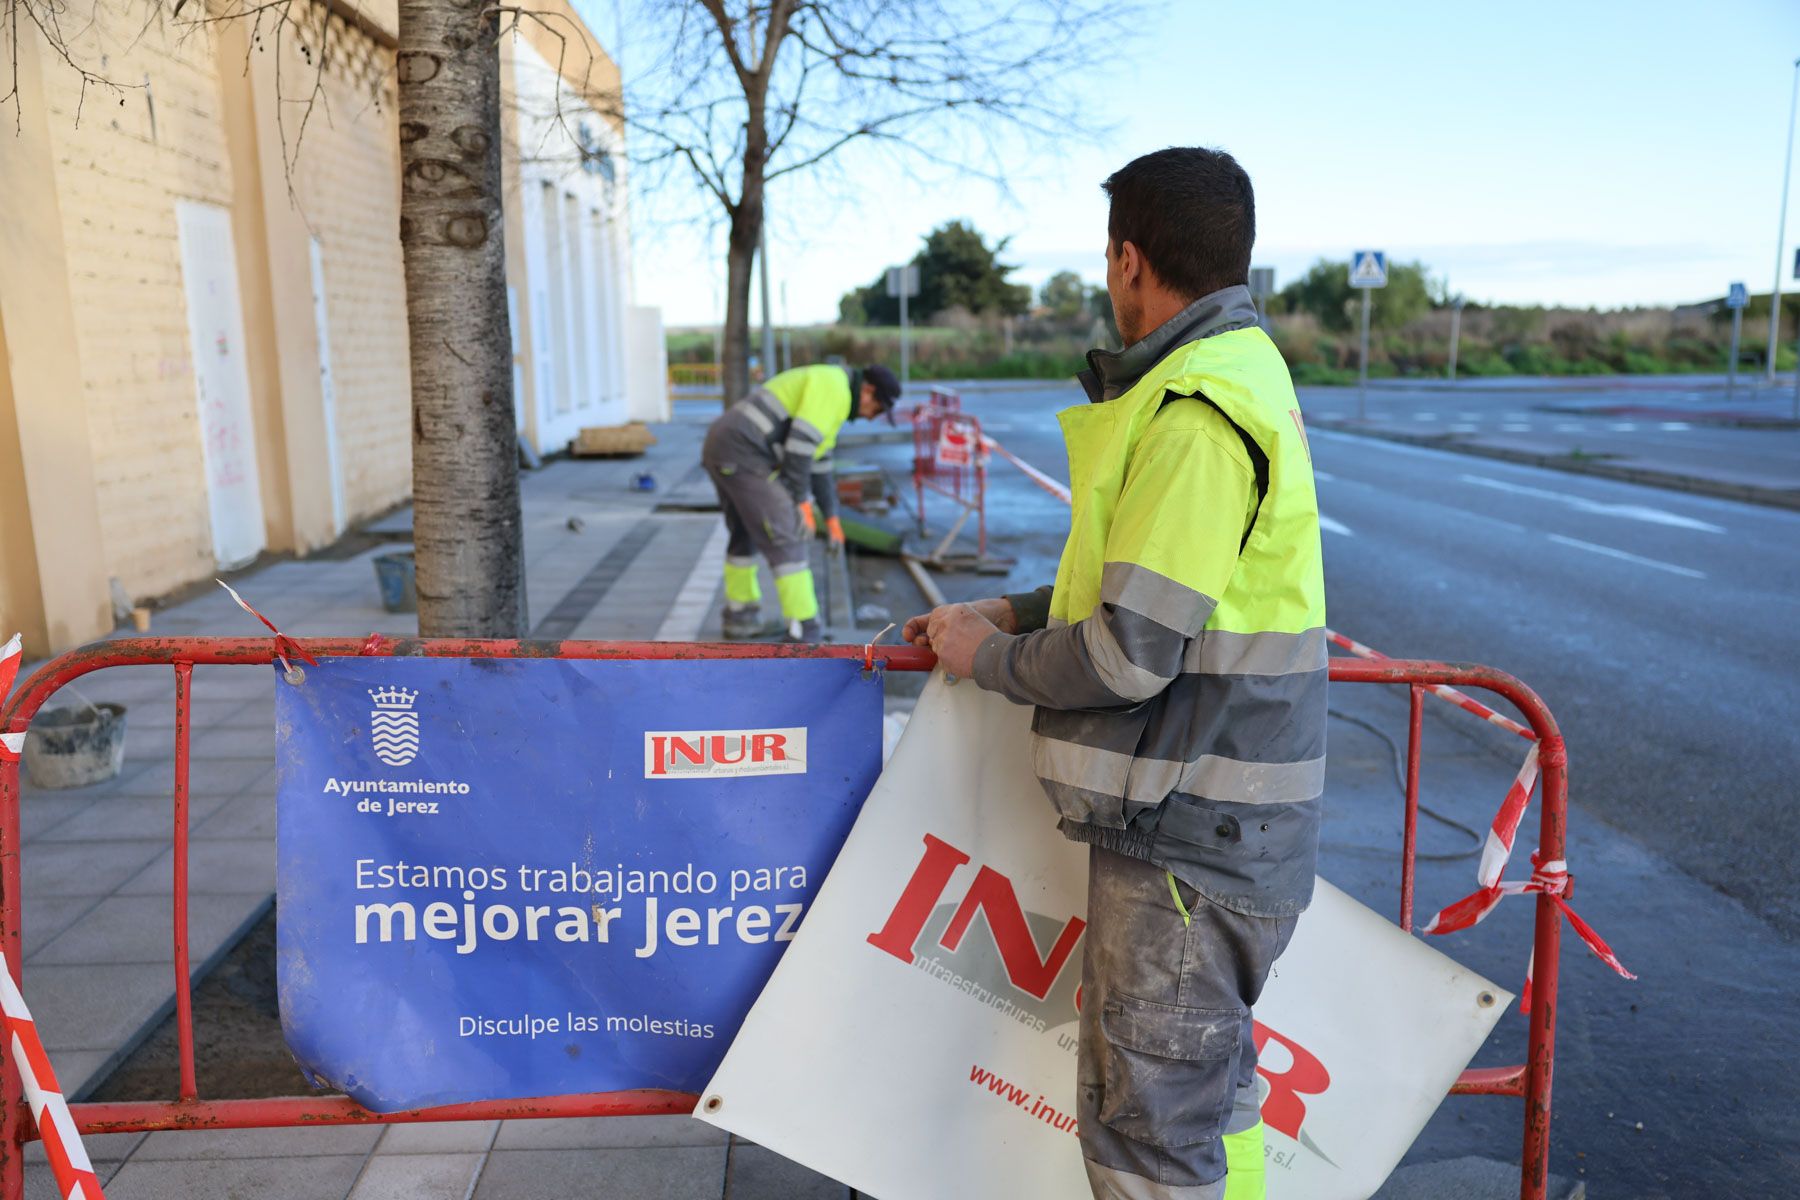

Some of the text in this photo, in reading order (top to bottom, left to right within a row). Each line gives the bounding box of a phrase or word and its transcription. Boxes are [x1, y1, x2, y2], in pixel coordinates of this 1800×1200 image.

[651, 733, 787, 774] INUR
[323, 777, 470, 796] Ayuntamiento
[357, 798, 439, 816] de Jerez
[356, 859, 807, 902] Estamos trabajando para
[355, 890, 803, 958] mejorar Jerez
[866, 833, 1331, 1141] INR
[459, 1012, 715, 1039] Disculpe las molestias
